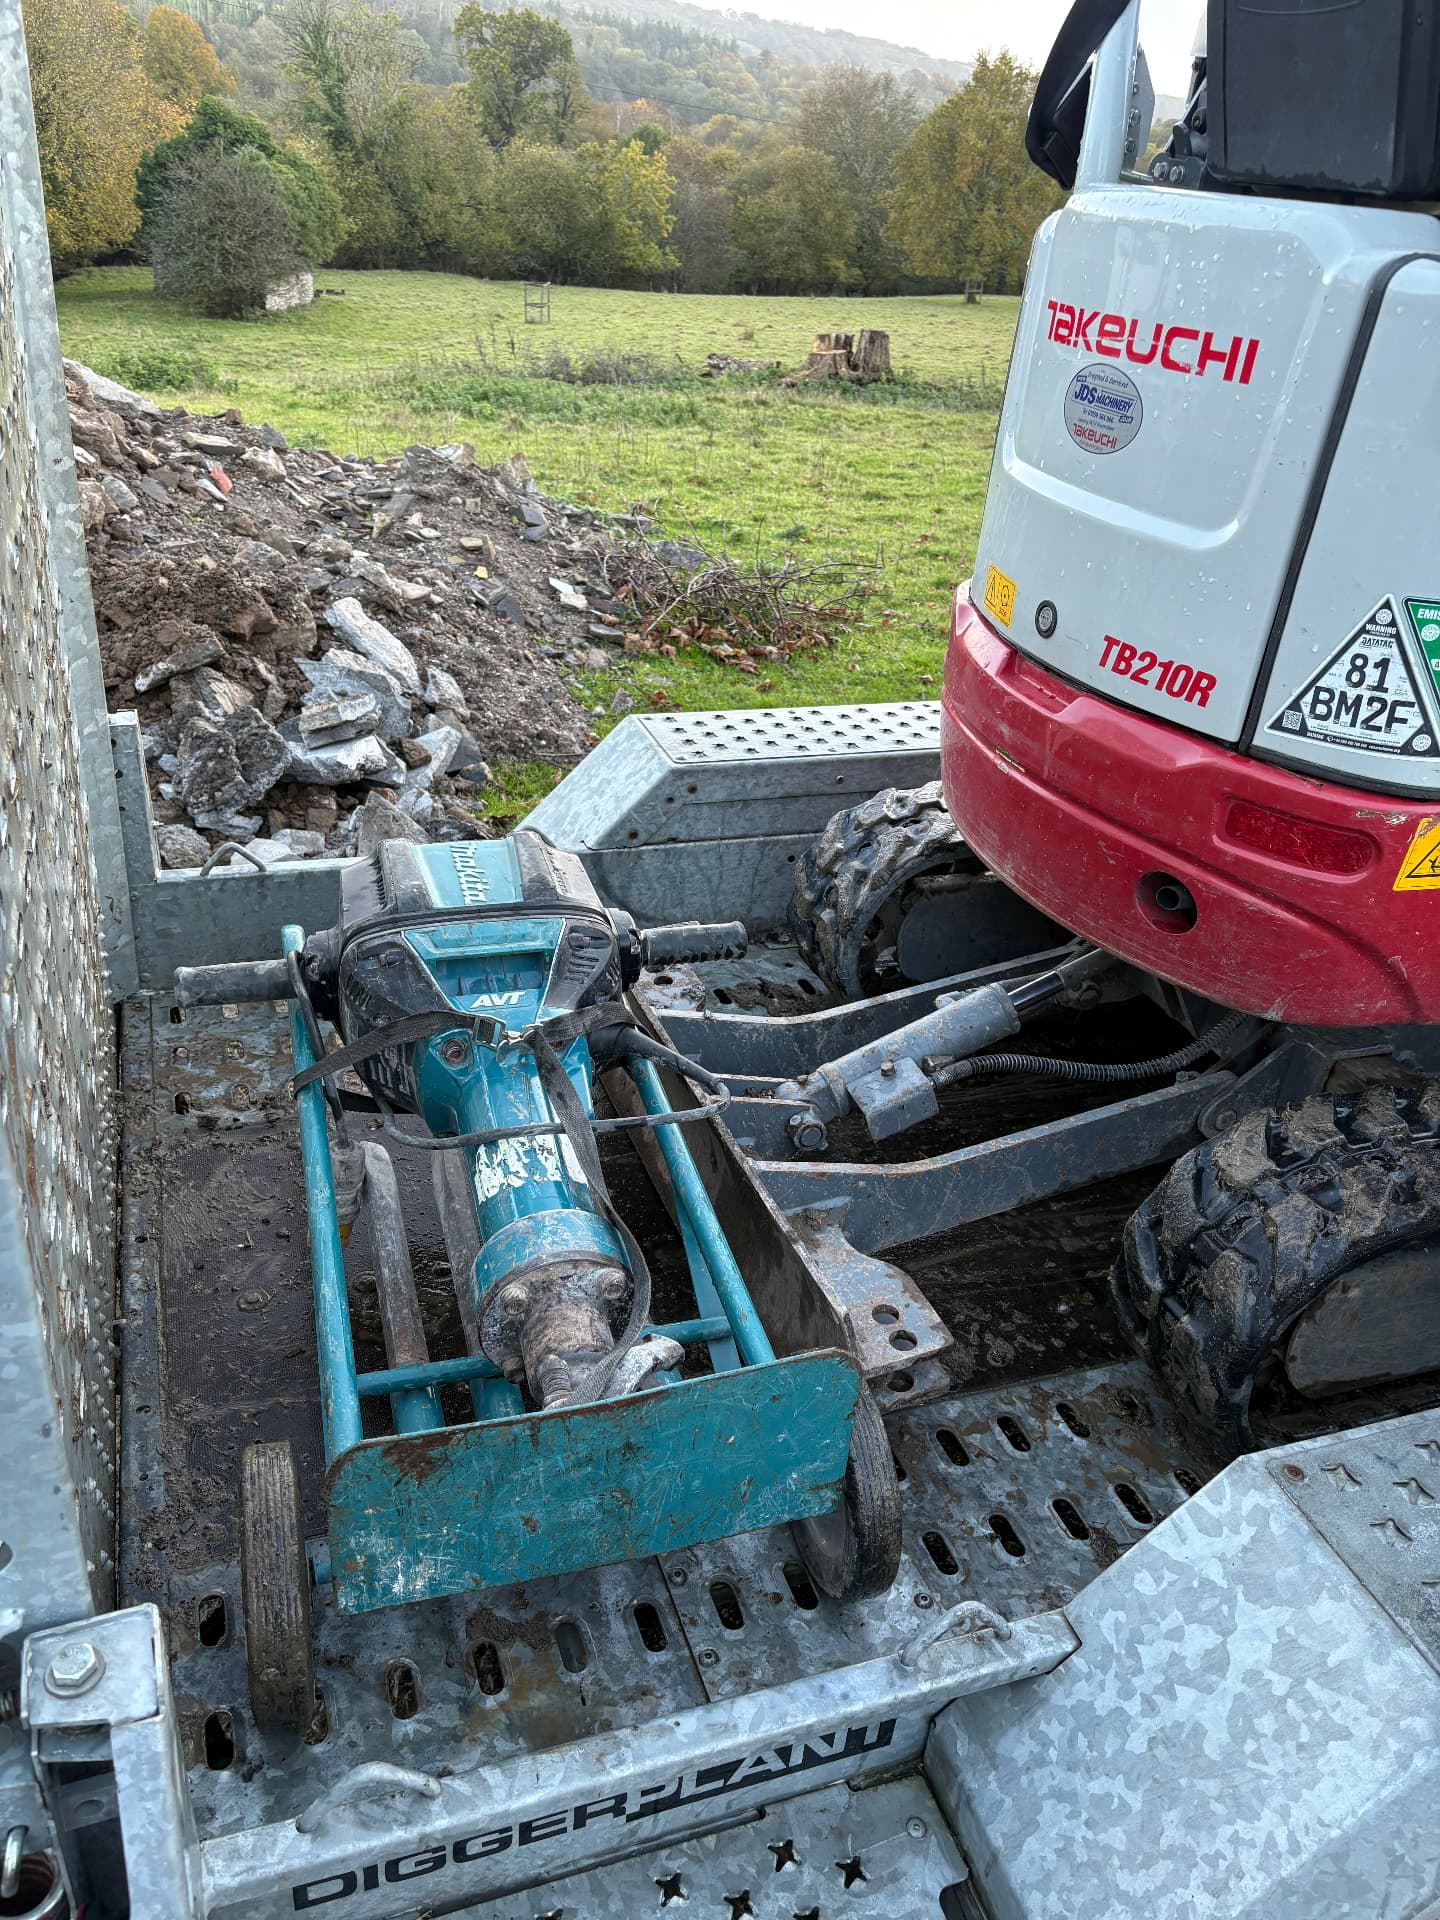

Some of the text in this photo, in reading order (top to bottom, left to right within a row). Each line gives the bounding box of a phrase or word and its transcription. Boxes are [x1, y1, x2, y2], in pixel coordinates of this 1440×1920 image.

[1074, 383, 1134, 414] JDS MACHINERY
[1365, 623, 1397, 635] WARNING
[1098, 634, 1217, 708] TB210R
[1345, 652, 1391, 694] 81
[1308, 685, 1416, 734] BM2F
[470, 991, 526, 1009] AVT
